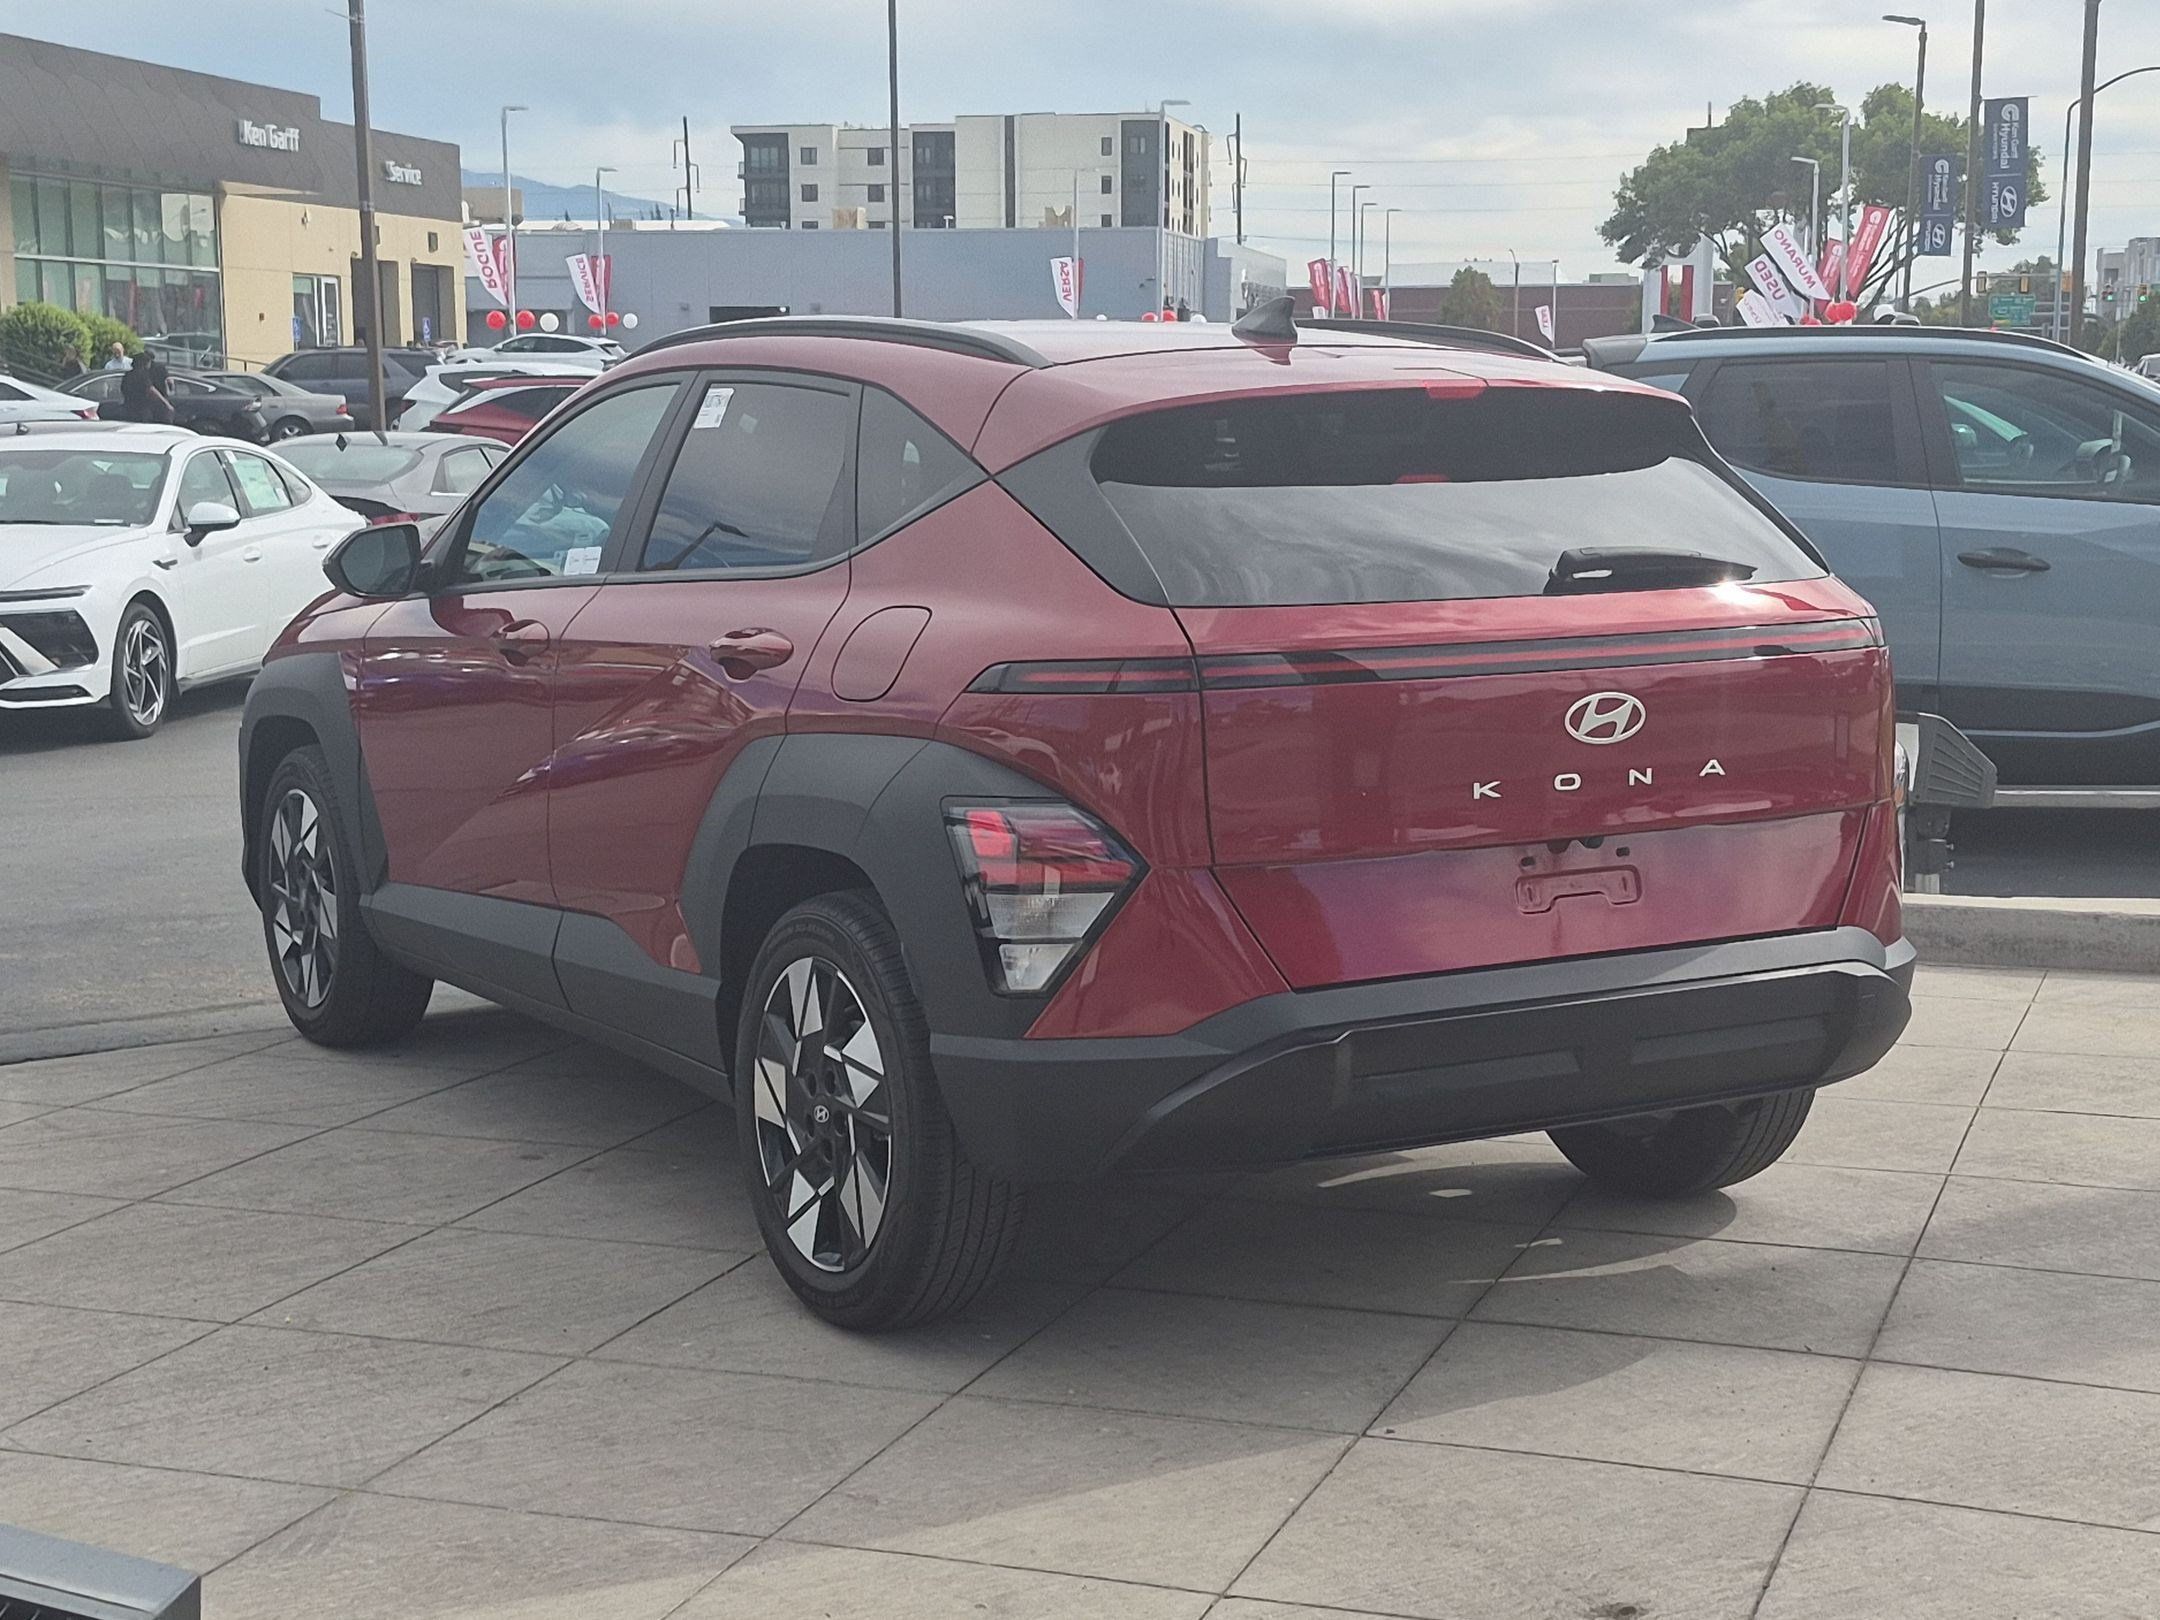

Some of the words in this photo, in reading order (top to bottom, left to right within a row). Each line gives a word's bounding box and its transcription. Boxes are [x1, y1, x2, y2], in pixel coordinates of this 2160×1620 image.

[238, 120, 267, 147] Ken
[268, 124, 299, 152] Garff
[1999, 123, 2010, 169] Hyundai
[386, 160, 422, 186] Service
[1473, 758, 1726, 800] KONA
